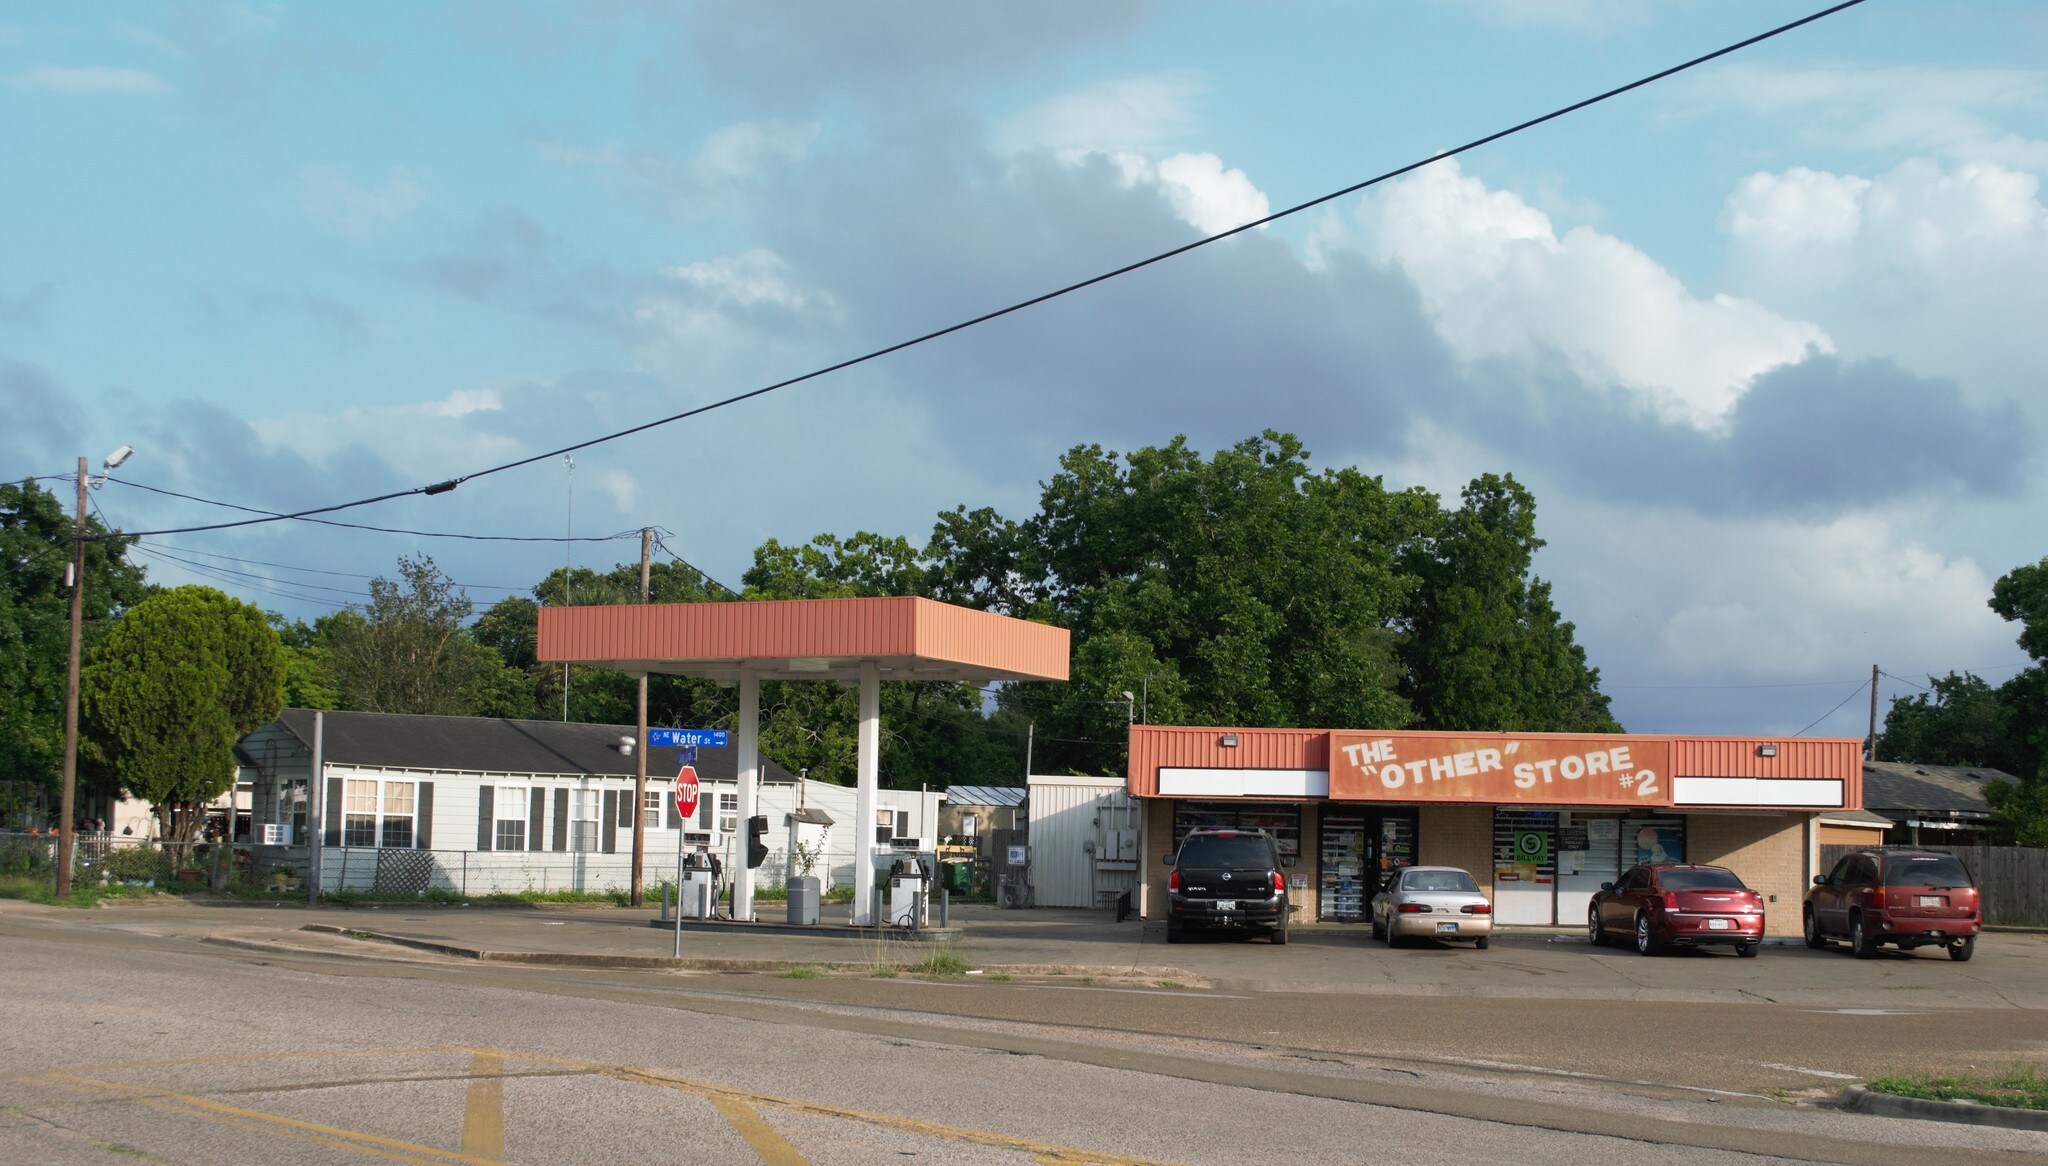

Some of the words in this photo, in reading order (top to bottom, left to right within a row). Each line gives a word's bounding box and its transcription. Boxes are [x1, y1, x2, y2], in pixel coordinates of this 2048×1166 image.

[672, 732, 702, 744] Water
[1341, 738, 1397, 767] THE
[1360, 741, 1520, 789] "OTHER"
[1513, 746, 1634, 789] STORE
[1618, 769, 1659, 796] #2
[677, 783, 697, 803] STOP
[1516, 854, 1531, 862] BILL
